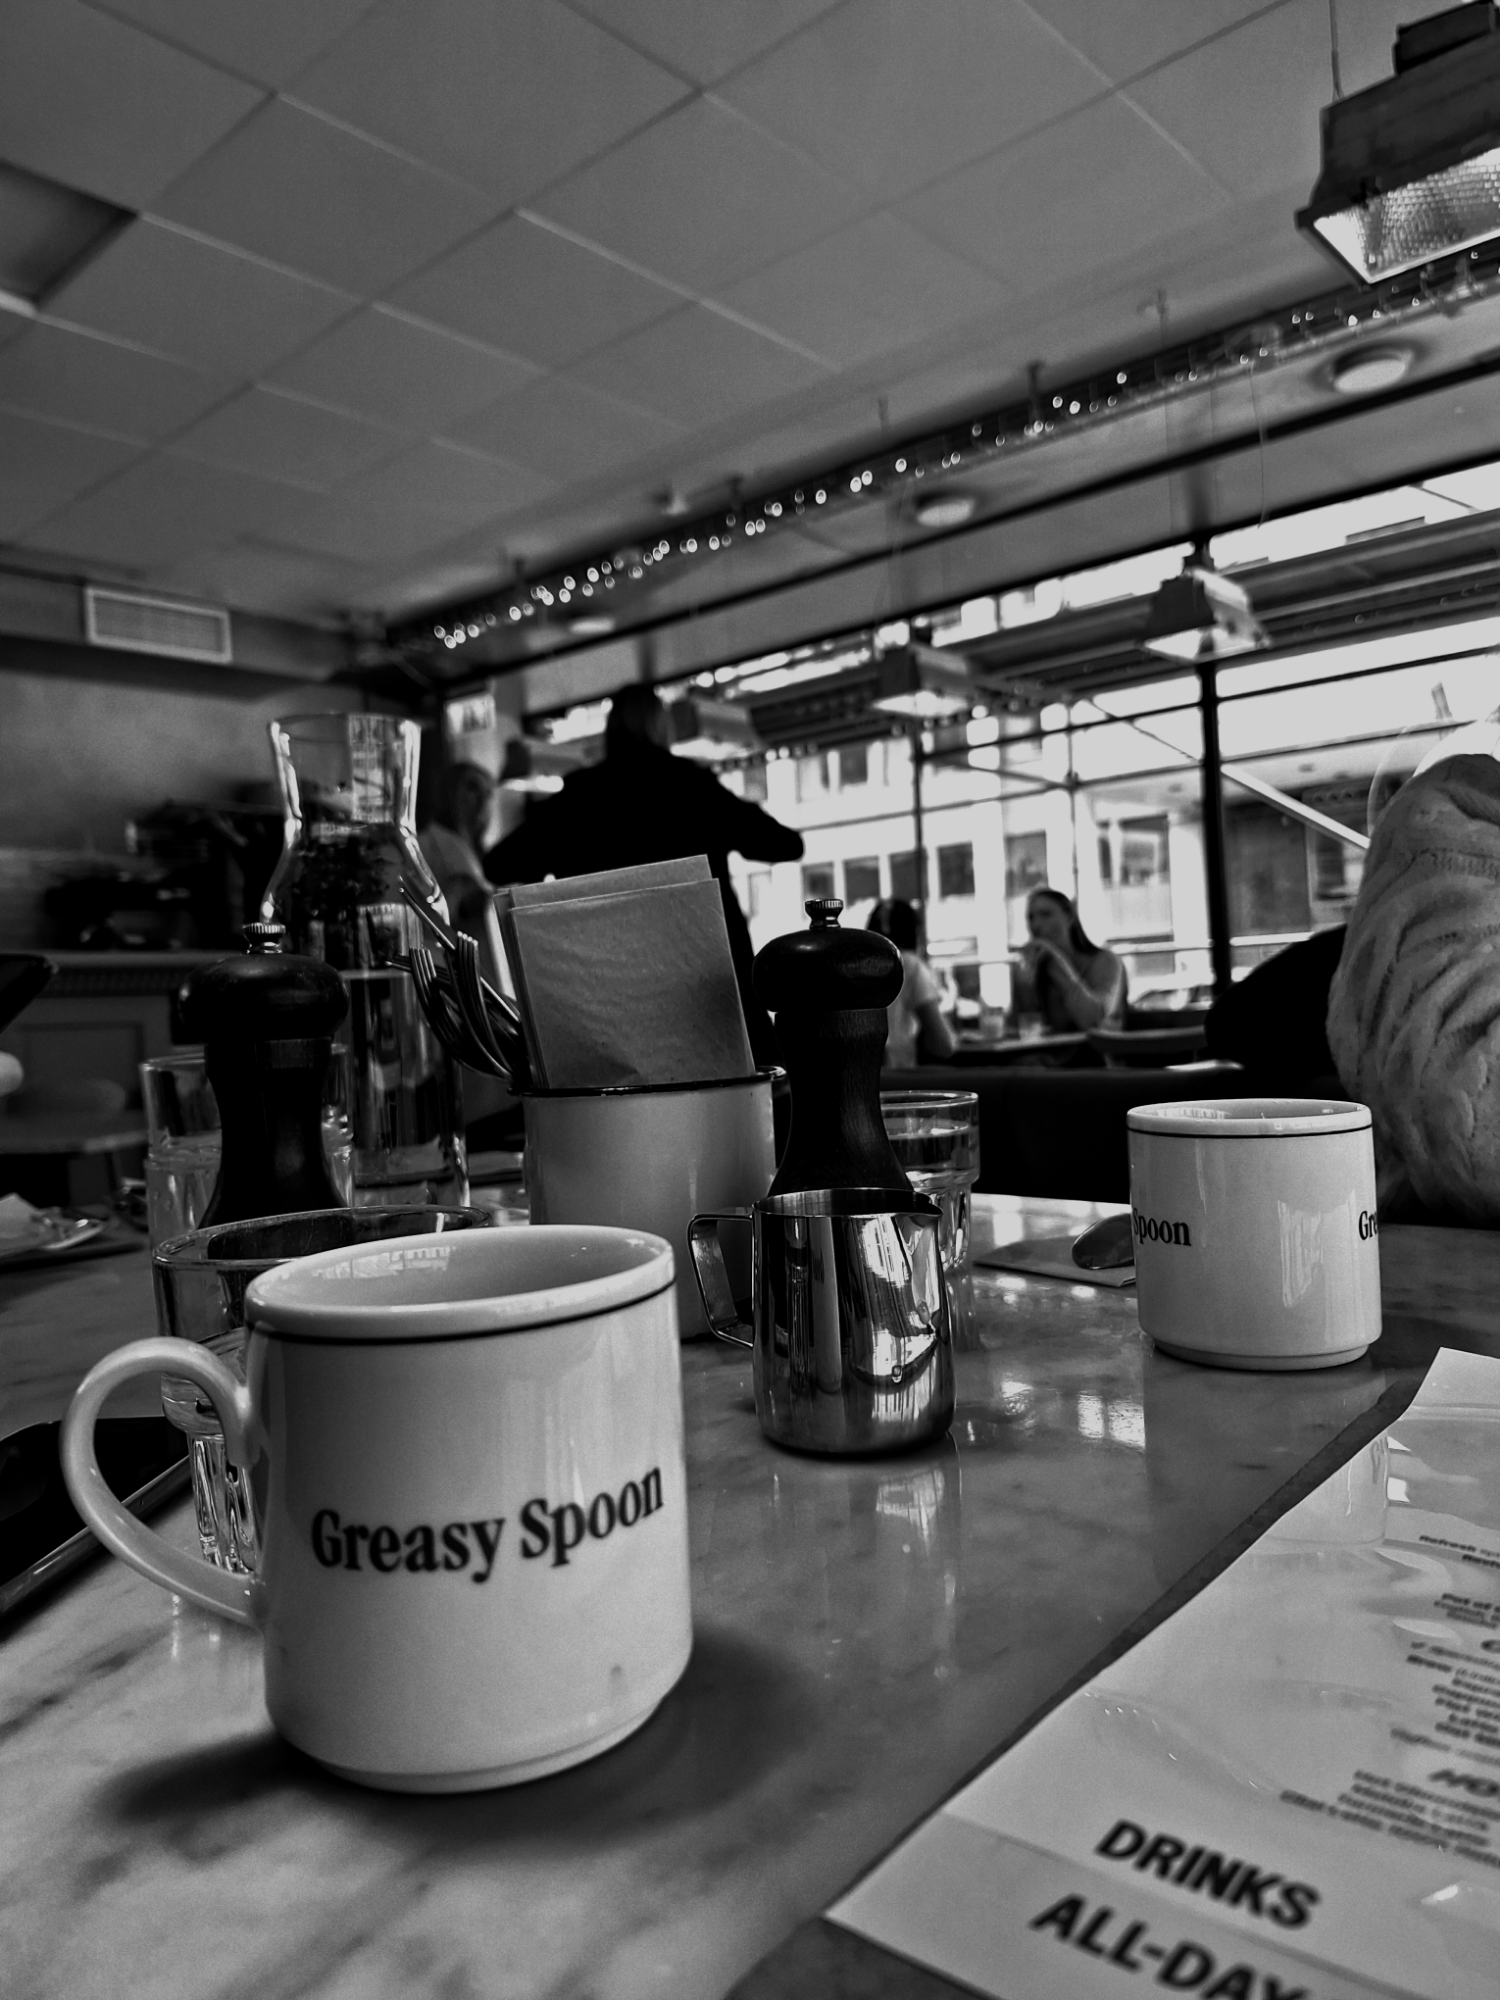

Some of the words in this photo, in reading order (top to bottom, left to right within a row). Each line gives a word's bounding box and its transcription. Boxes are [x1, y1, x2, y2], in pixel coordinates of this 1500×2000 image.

[1133, 1207, 1192, 1247] Spoon
[311, 1508, 506, 1585] Greasy
[519, 1466, 665, 1568] Spoon
[1093, 1818, 1322, 1931] DRINKS
